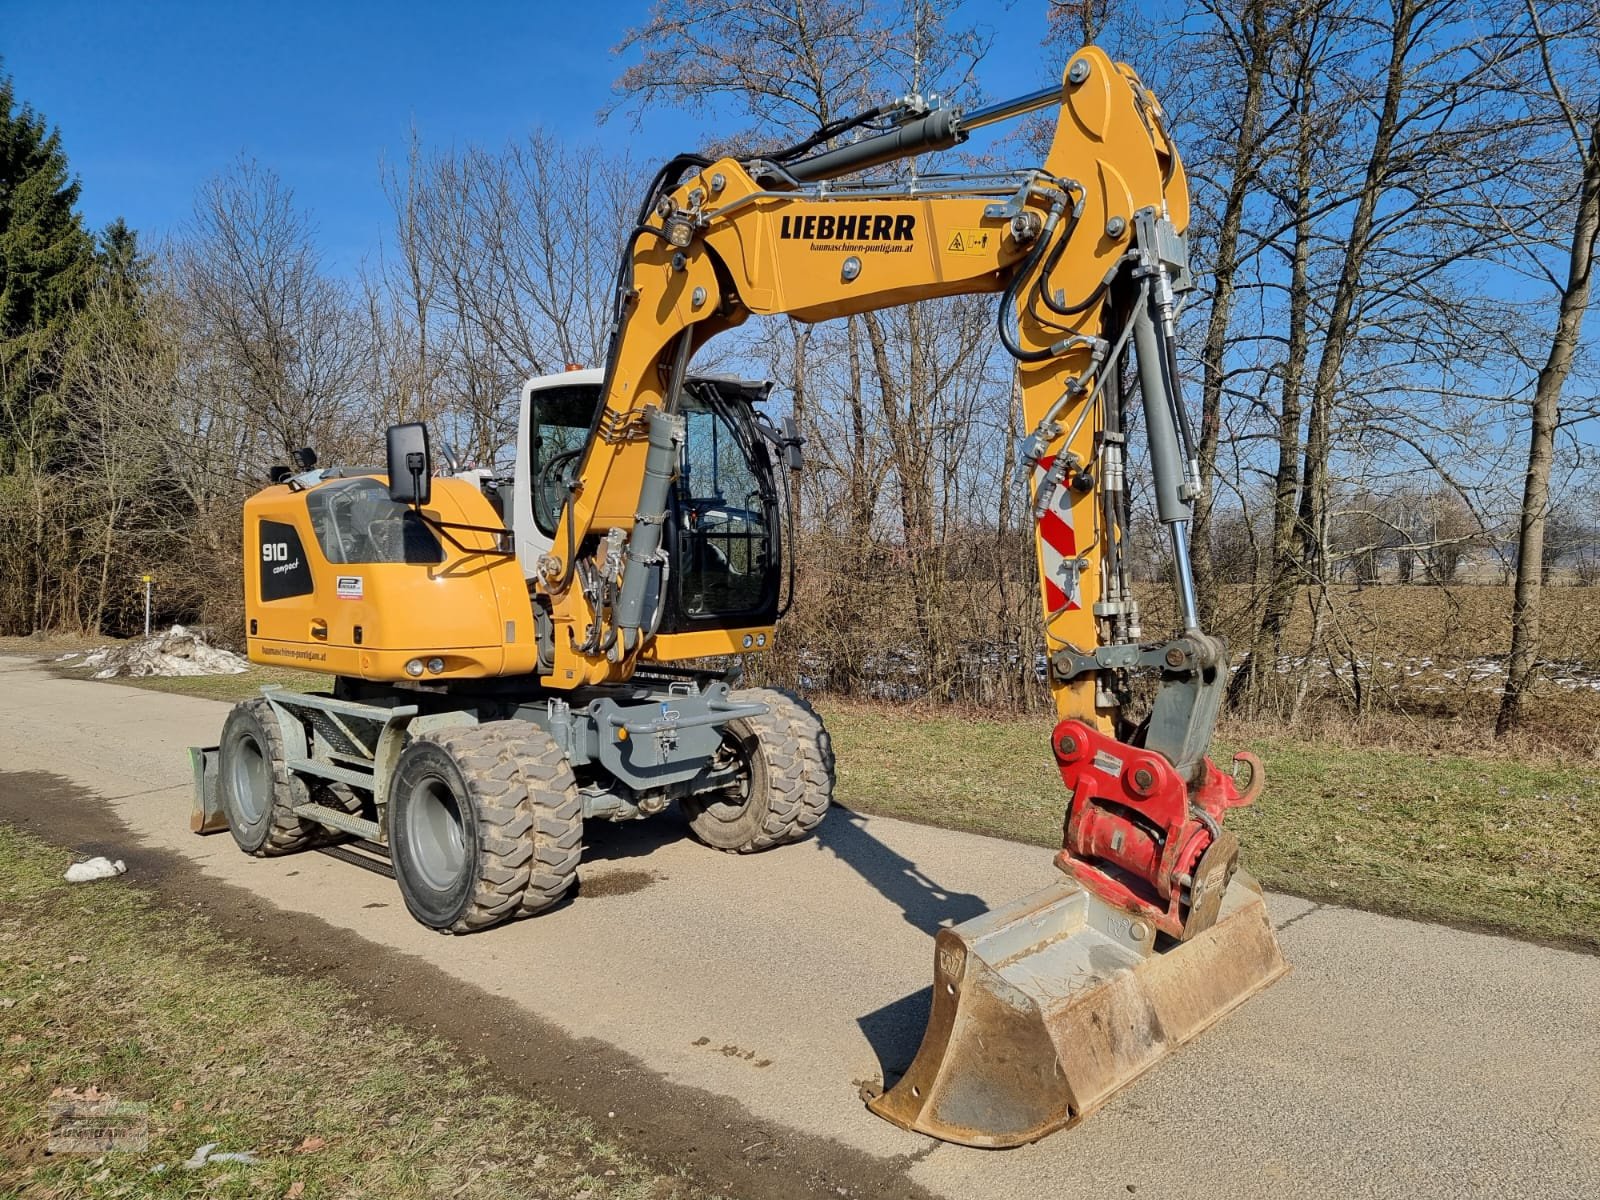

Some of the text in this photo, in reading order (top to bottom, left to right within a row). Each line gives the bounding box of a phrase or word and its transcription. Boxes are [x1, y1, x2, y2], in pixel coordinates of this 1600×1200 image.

[780, 215, 916, 240] LIEBHERR
[810, 242, 914, 253] baumaschinen-puntigam.at
[263, 543, 288, 561] 910
[273, 558, 299, 574] compact
